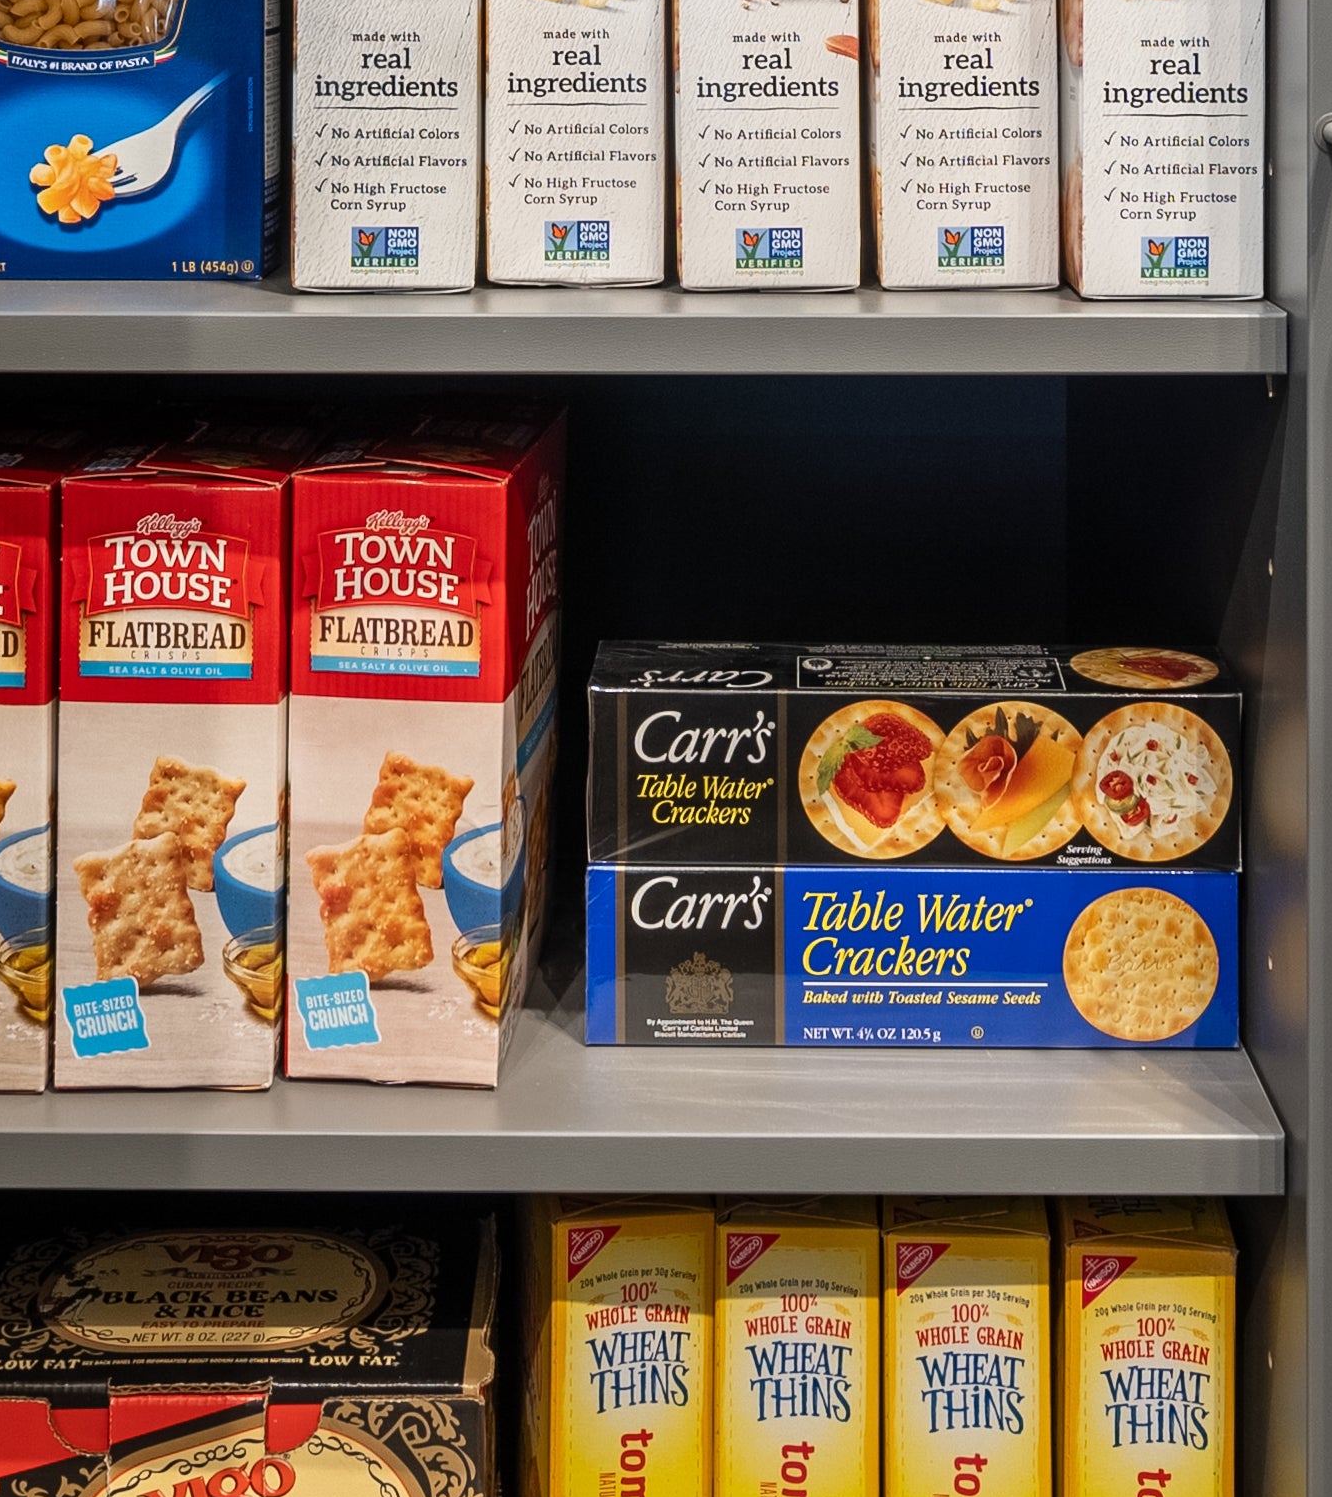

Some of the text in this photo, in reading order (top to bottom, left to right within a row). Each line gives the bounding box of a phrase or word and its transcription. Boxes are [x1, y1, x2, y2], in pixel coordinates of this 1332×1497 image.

[11, 56, 150, 71] ITALY'S #1 BRAND OF PASTA
[361, 48, 411, 69] real
[315, 75, 458, 100] ingredients
[331, 128, 460, 140] No Artificial Colors
[105, 535, 227, 571] TOWN
[335, 533, 455, 569] TOWN
[104, 572, 231, 608] HOUSE
[334, 566, 458, 606] HOUSE
[89, 621, 246, 650] FLATBREAD
[319, 616, 474, 648] FLATBREAD
[634, 711, 770, 763] Carr's
[637, 775, 768, 799] Table Water
[652, 801, 751, 825] Crackers
[630, 876, 766, 930] Carr's
[803, 893, 1026, 933] Table Water
[802, 938, 971, 976] Crackers
[803, 991, 1041, 1005] Baked with Toasted Sesame Seeds
[586, 1331, 691, 1369] WHEAT
[745, 1341, 853, 1379] WHEAT
[916, 1353, 1025, 1391] WHEAT
[1101, 1366, 1210, 1405] WHEAT
